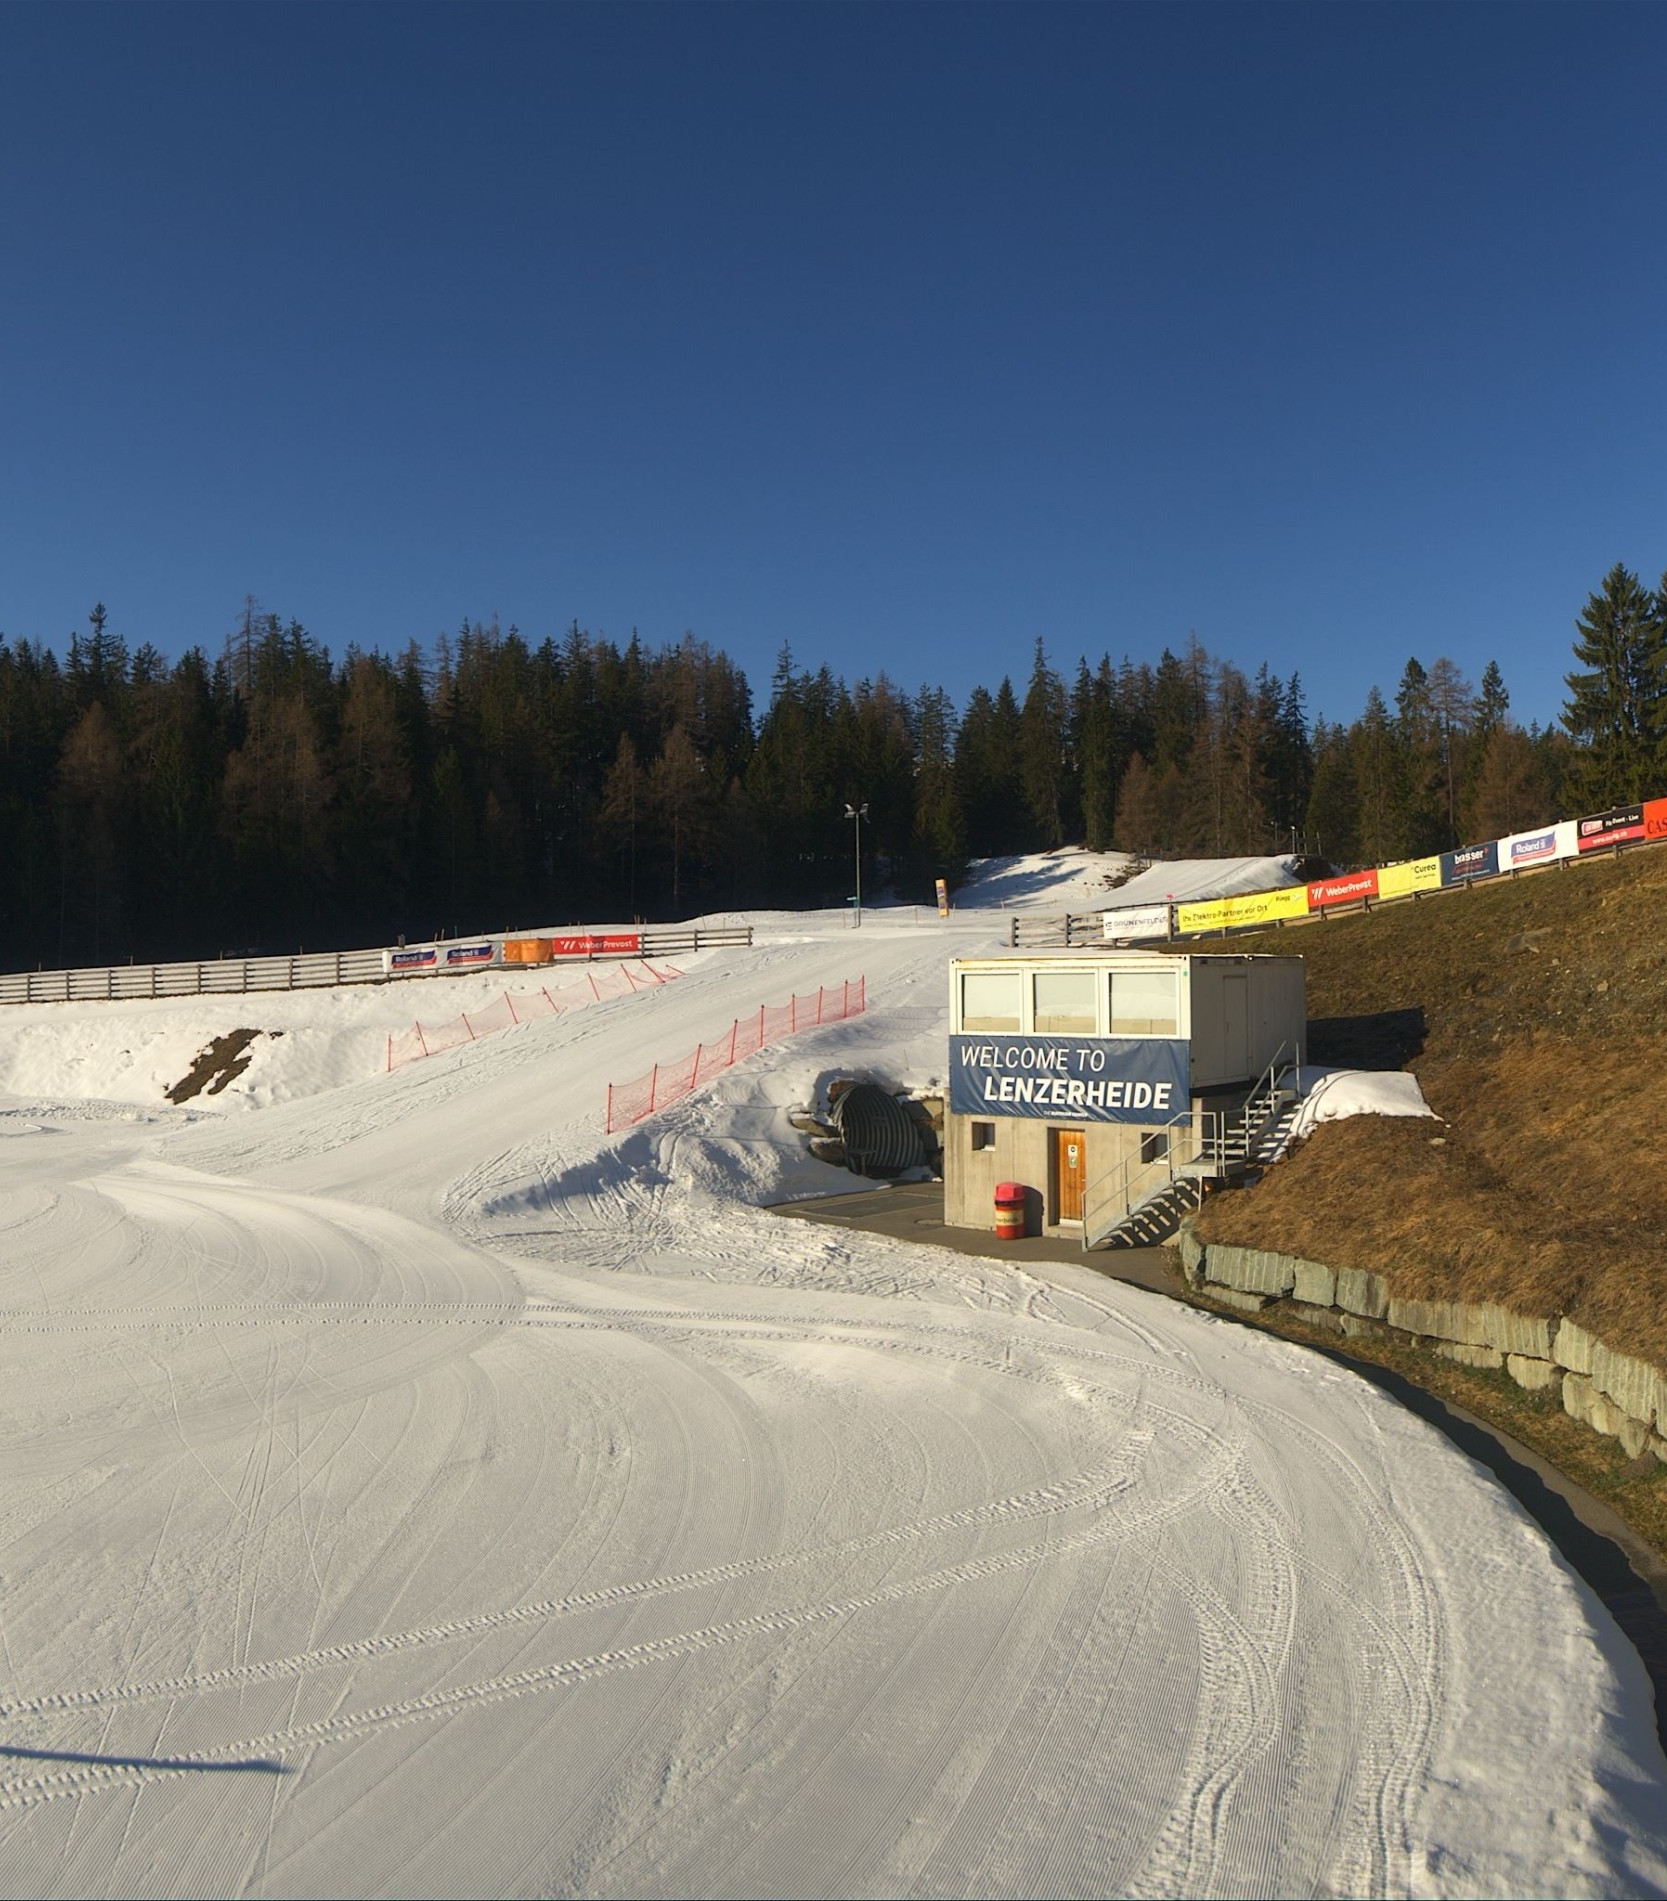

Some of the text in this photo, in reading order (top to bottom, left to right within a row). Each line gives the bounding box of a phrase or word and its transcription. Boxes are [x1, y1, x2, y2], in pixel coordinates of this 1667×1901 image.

[1516, 841, 1539, 853] Roland
[1454, 850, 1483, 865] brasser
[1414, 863, 1436, 874] Curea
[1325, 879, 1372, 897] WeberPrevost
[578, 939, 633, 950] WeberPrevost
[961, 1045, 1106, 1072] WELCOME TO
[984, 1076, 1172, 1110] LENZERHEIDE
